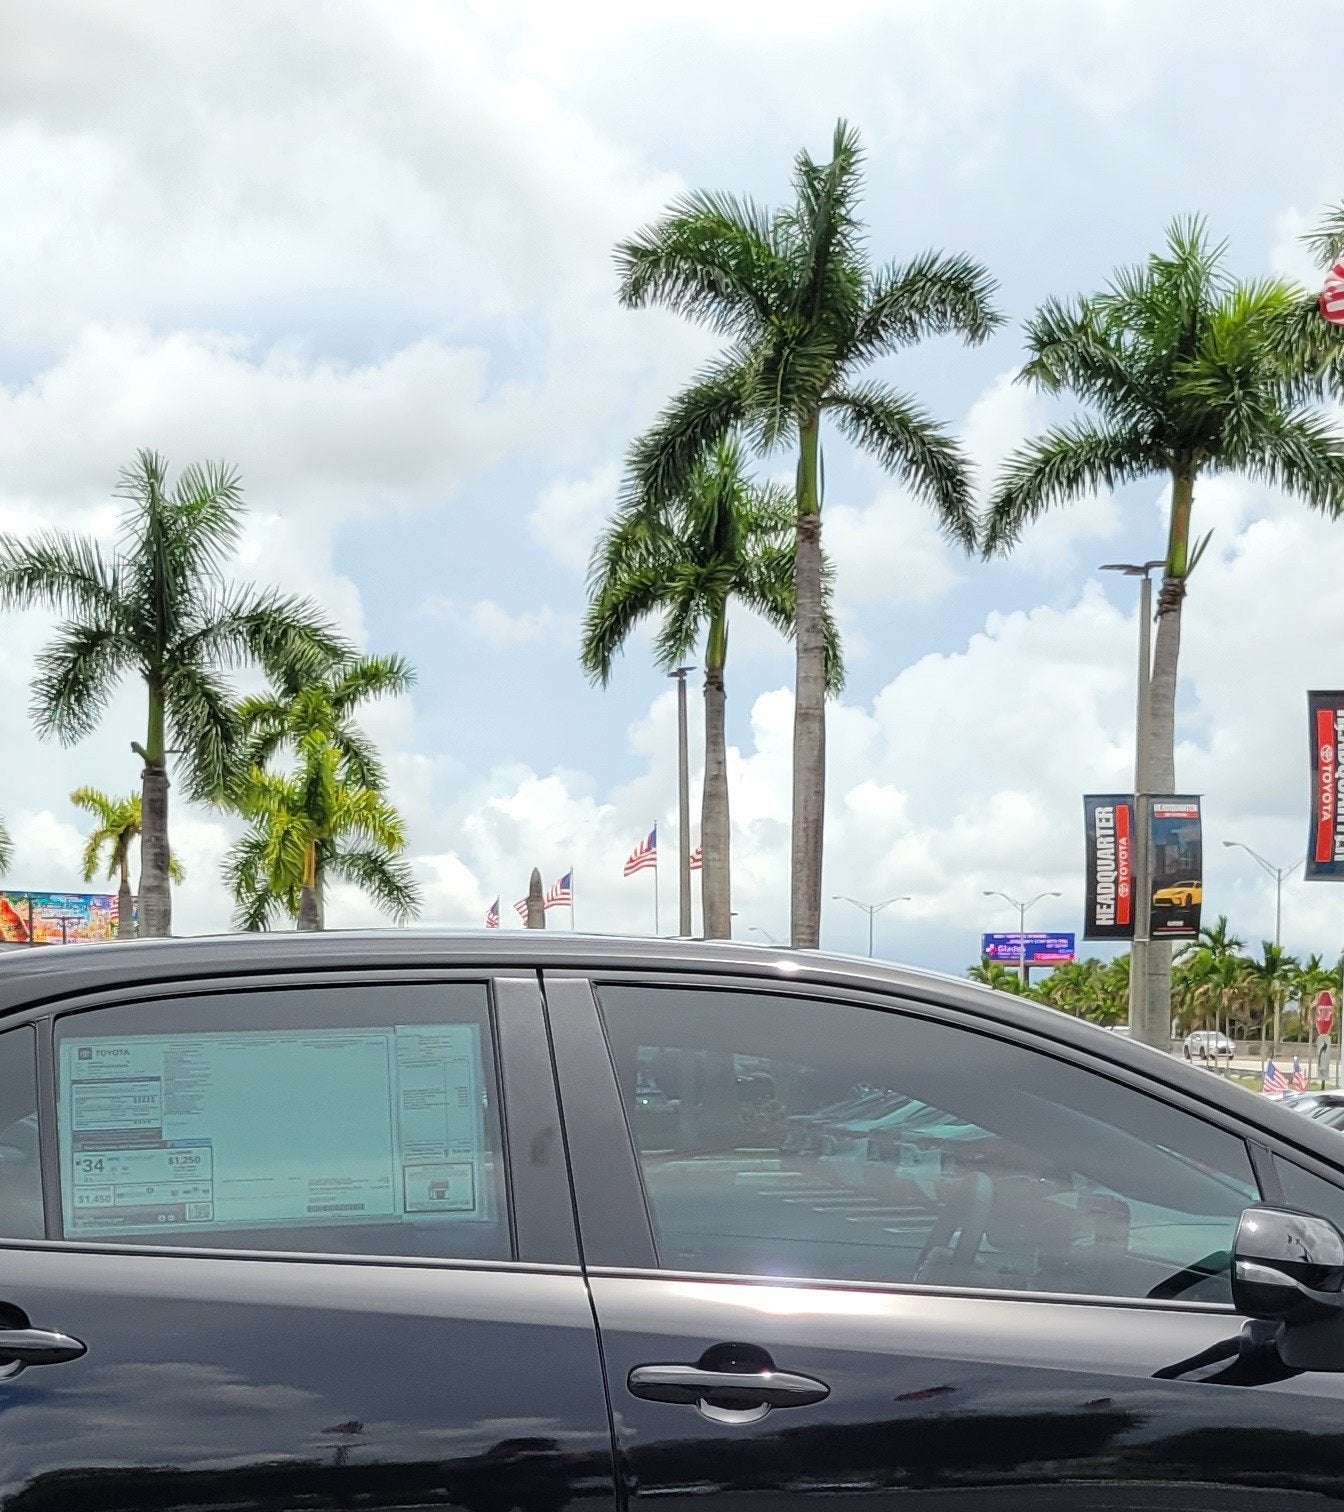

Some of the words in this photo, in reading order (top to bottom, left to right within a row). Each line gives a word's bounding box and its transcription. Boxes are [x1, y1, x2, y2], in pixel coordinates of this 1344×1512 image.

[1321, 765, 1332, 821] TOYOTA
[1095, 806, 1117, 926] HEADQUARTER
[1119, 837, 1129, 881] TOYOTA
[96, 1049, 131, 1057] TOYOTA
[82, 1158, 105, 1173] 34
